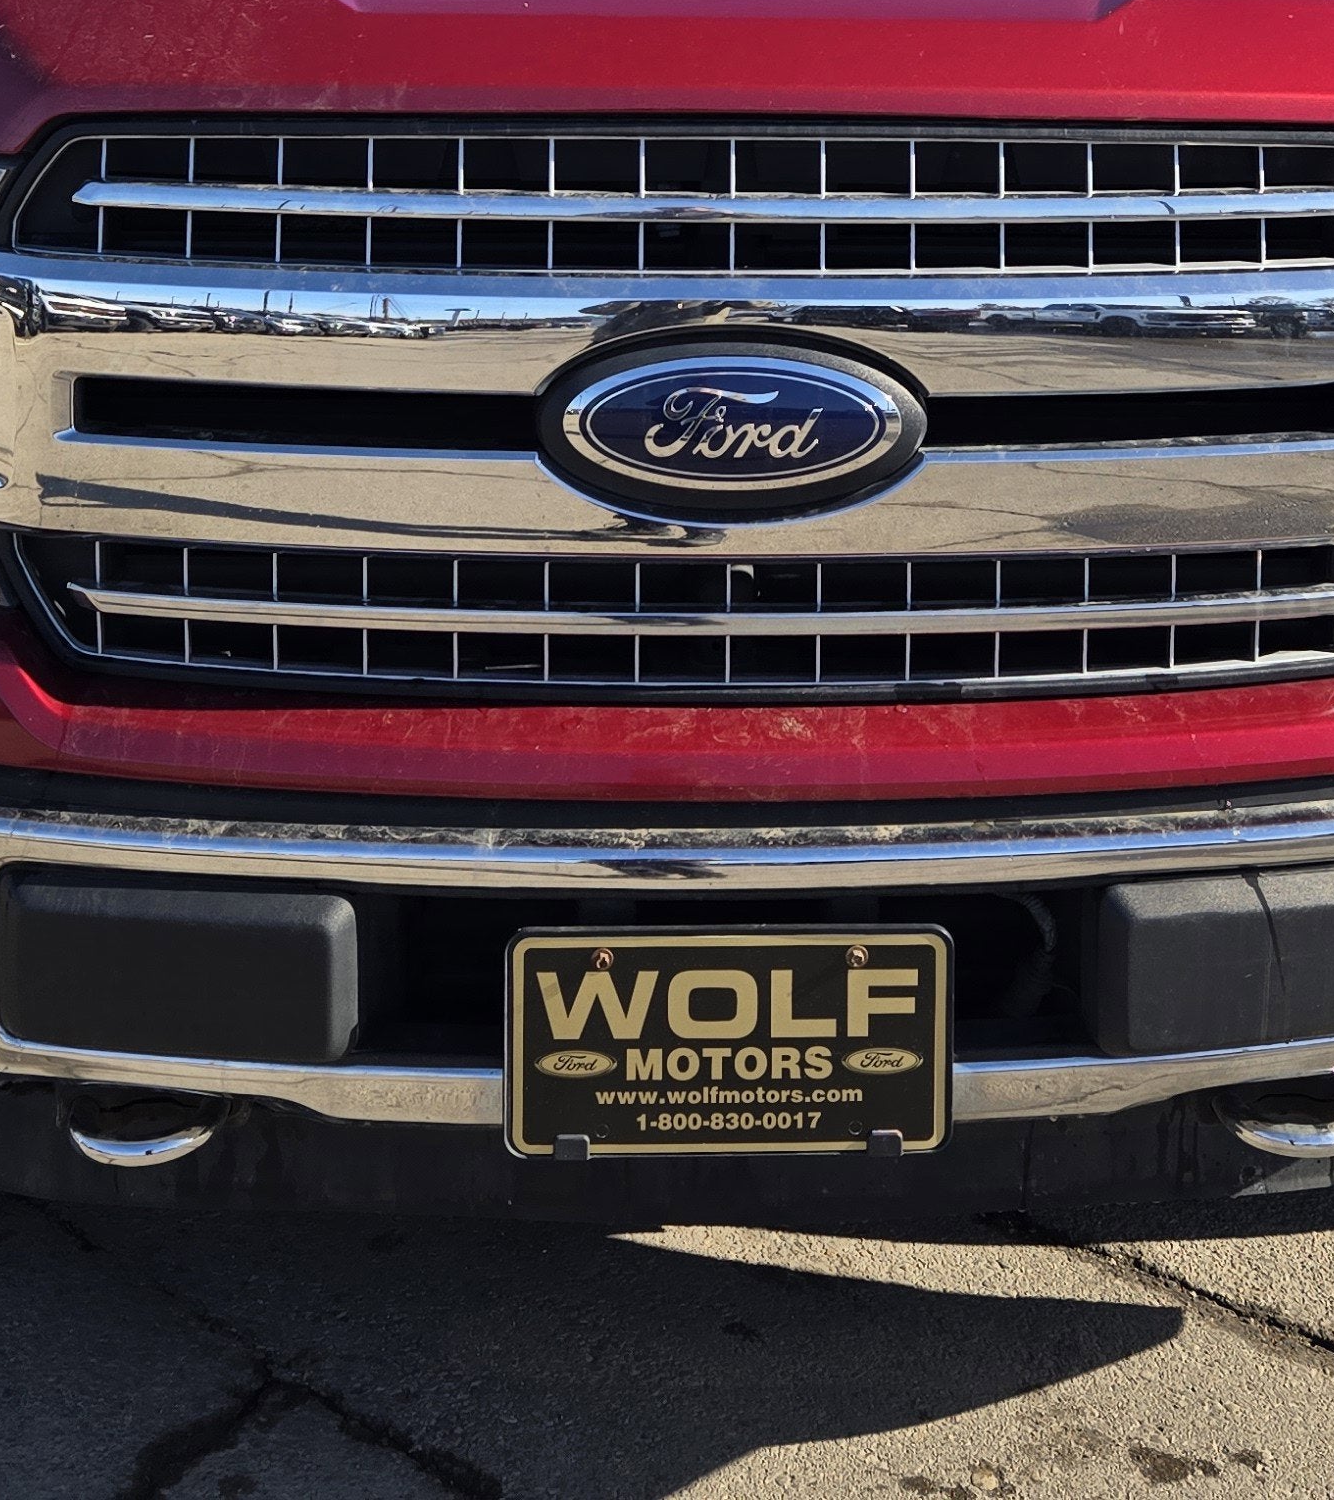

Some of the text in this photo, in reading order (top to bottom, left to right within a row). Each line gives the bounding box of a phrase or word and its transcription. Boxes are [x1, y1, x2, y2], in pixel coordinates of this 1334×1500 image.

[644, 386, 824, 460] Ford
[535, 967, 920, 1040] WOLF
[551, 1045, 905, 1082] Ford MOTORS Ford
[594, 1085, 864, 1106] www.wolfmotors.com
[635, 1111, 823, 1132] 1-800-830-0017
